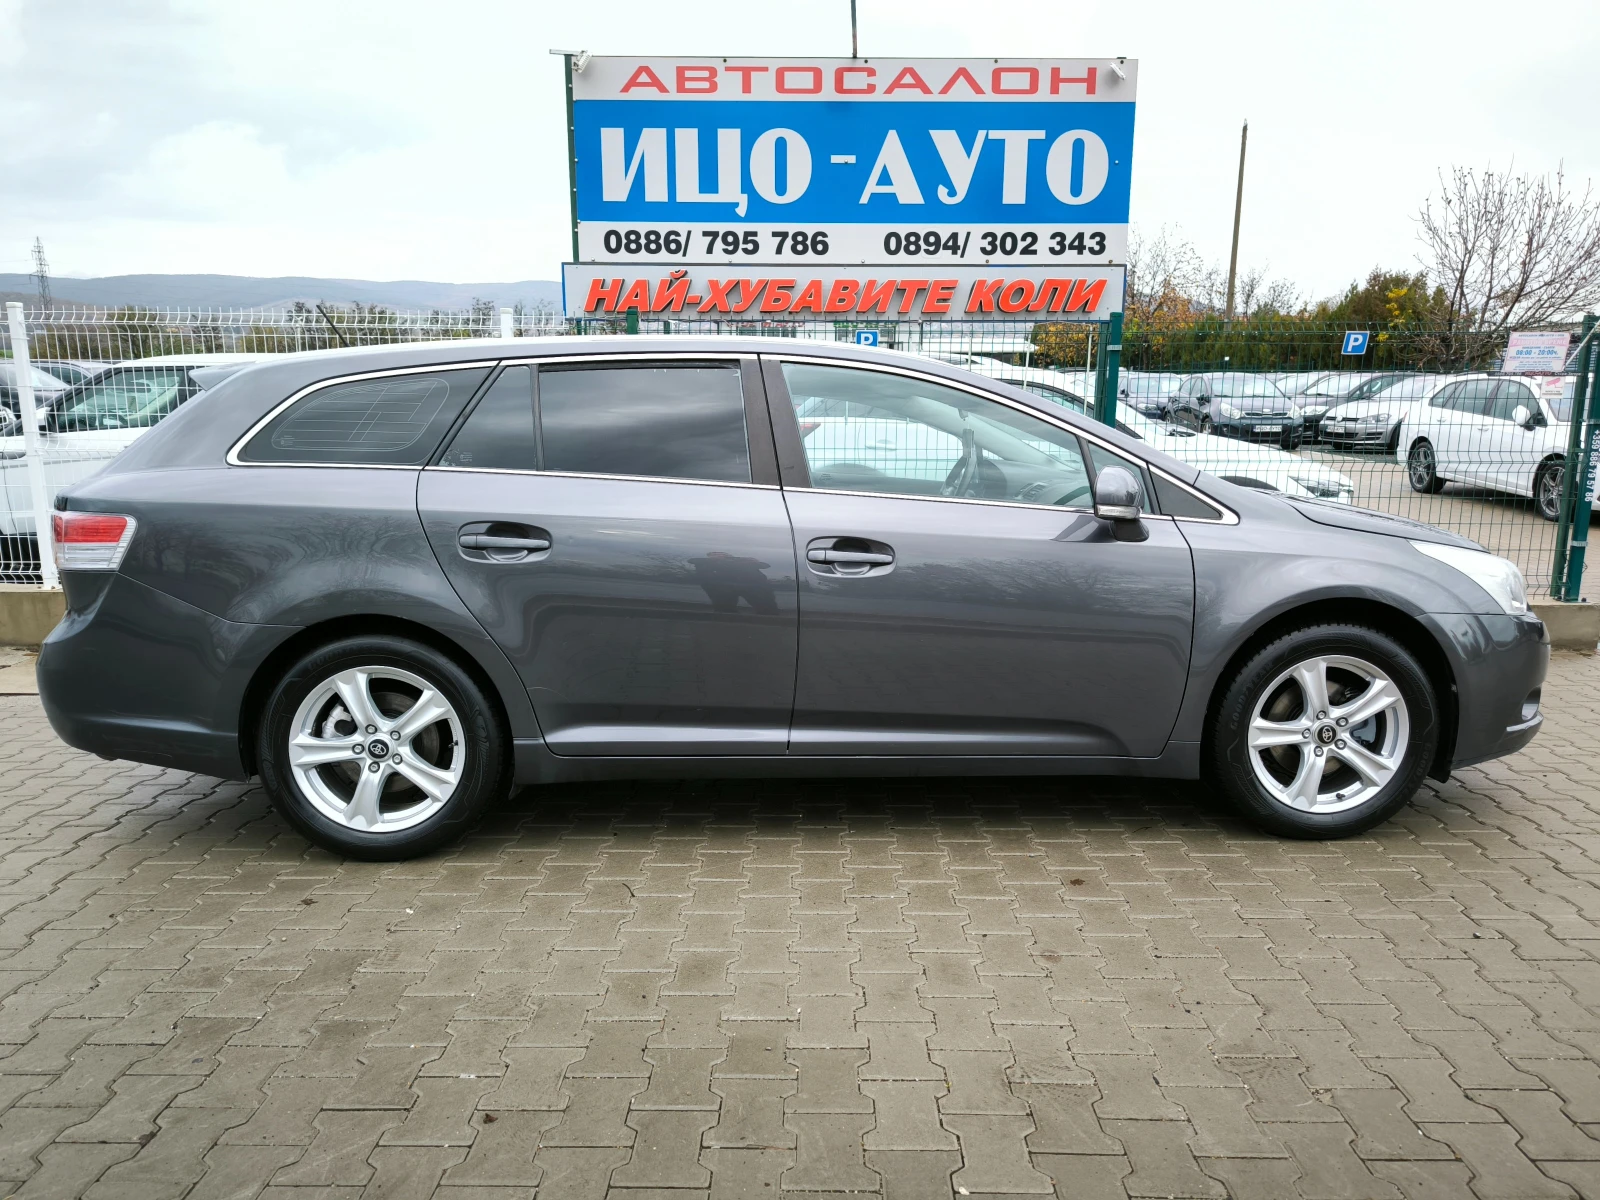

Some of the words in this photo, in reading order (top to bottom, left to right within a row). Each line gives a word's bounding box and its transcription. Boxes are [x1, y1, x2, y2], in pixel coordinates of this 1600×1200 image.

[620, 66, 1098, 95] АВТОСАЛОН
[603, 229, 692, 258] 0886/
[701, 230, 760, 256] 795
[771, 231, 829, 256] 786
[883, 230, 971, 259] 0894/
[979, 231, 1039, 256] 302
[1048, 231, 1107, 256] 343
[584, 269, 959, 314] НАЙ-ХУБАВИТЕ
[966, 277, 1109, 314] КОЛИ
[1347, 334, 1363, 352] P
[1589, 451, 1598, 466] 886
[1587, 468, 1596, 478] 79
[1586, 480, 1595, 490] 57
[1584, 492, 1593, 502] 86
